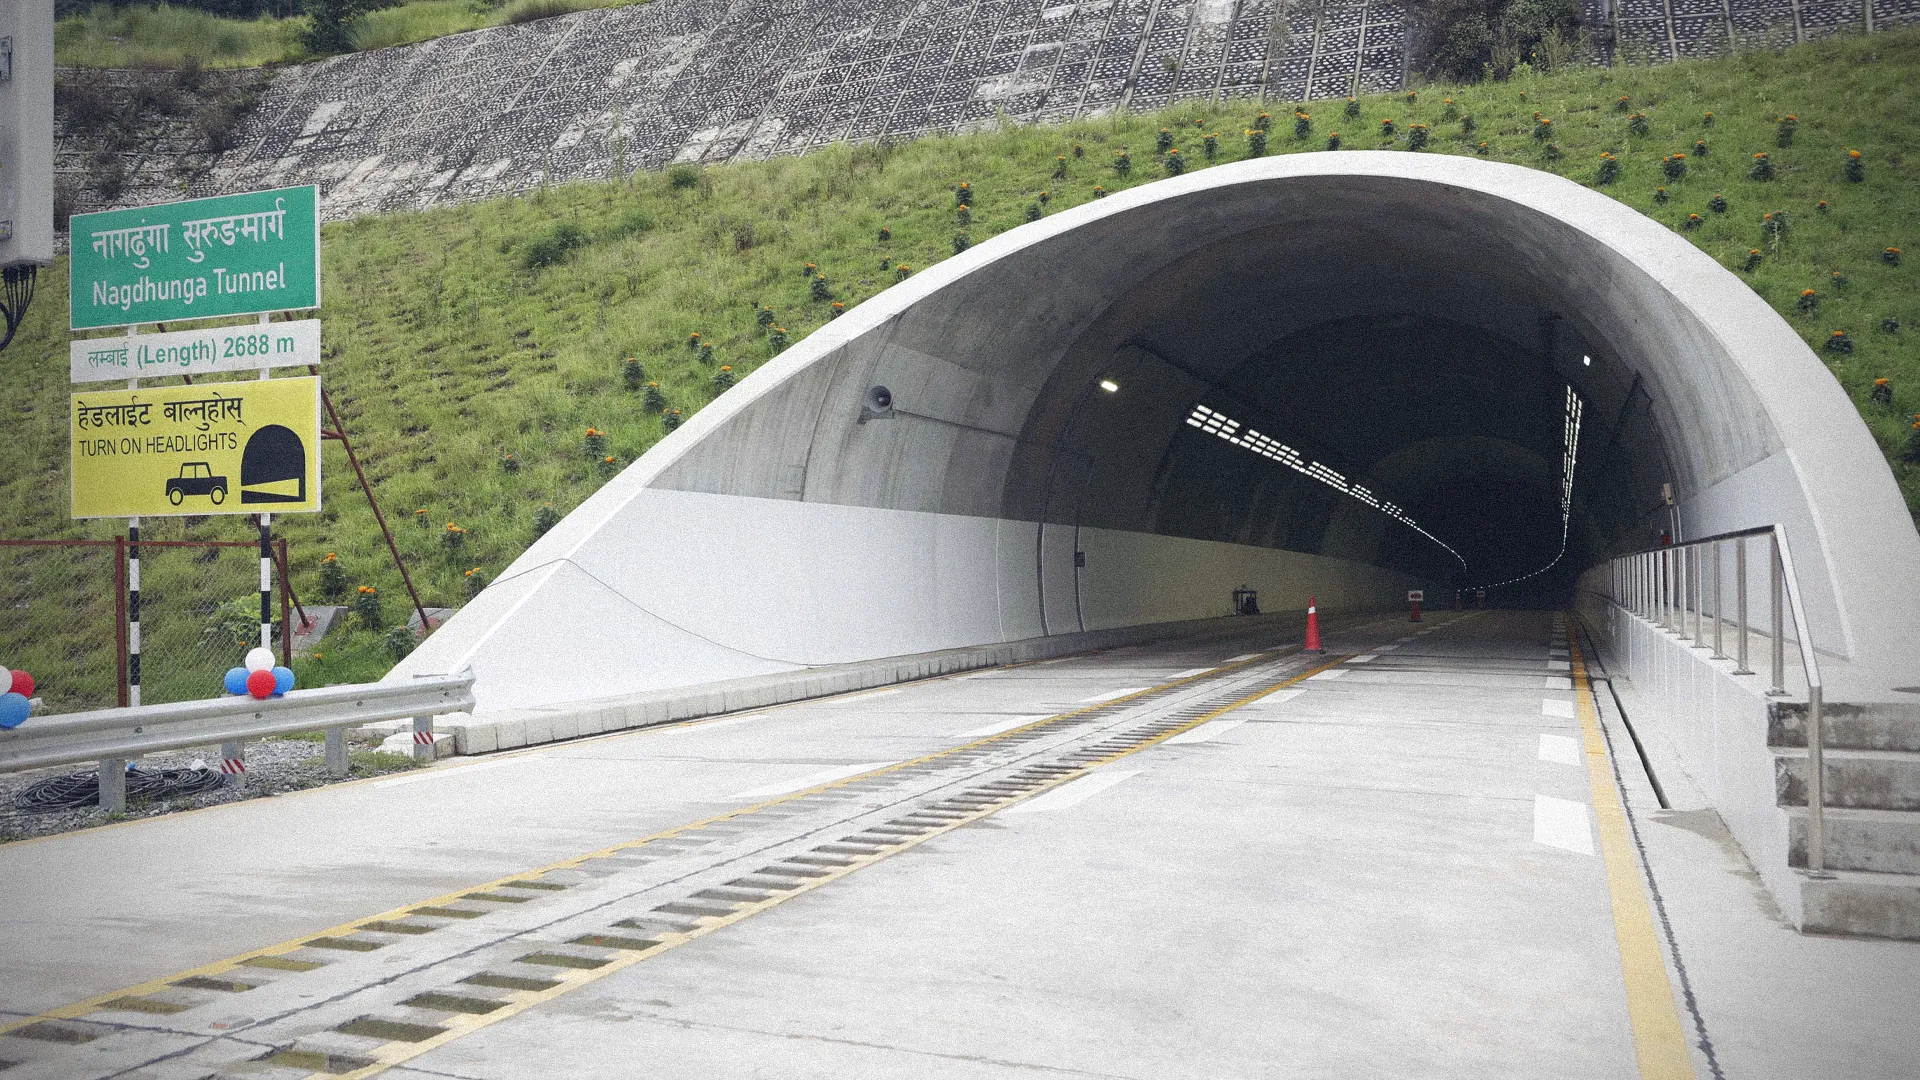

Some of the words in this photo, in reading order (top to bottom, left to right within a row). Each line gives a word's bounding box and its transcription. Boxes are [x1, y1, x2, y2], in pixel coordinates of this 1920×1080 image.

[91, 218, 171, 268] नागढुंगा
[182, 197, 286, 262] सुरुङमार्ग
[93, 276, 207, 311] Nagdhunga
[213, 262, 286, 294] Tunnel
[88, 341, 129, 368] लम्बाई
[137, 338, 217, 369] (Length)
[223, 333, 270, 358] 2688
[276, 336, 295, 353] m
[77, 395, 152, 430] हेडलाईट
[163, 392, 247, 431] बाल्नुहोस्
[79, 438, 117, 457] TURN
[120, 437, 142, 454] ON
[146, 431, 238, 454] HEADLIGHTS
